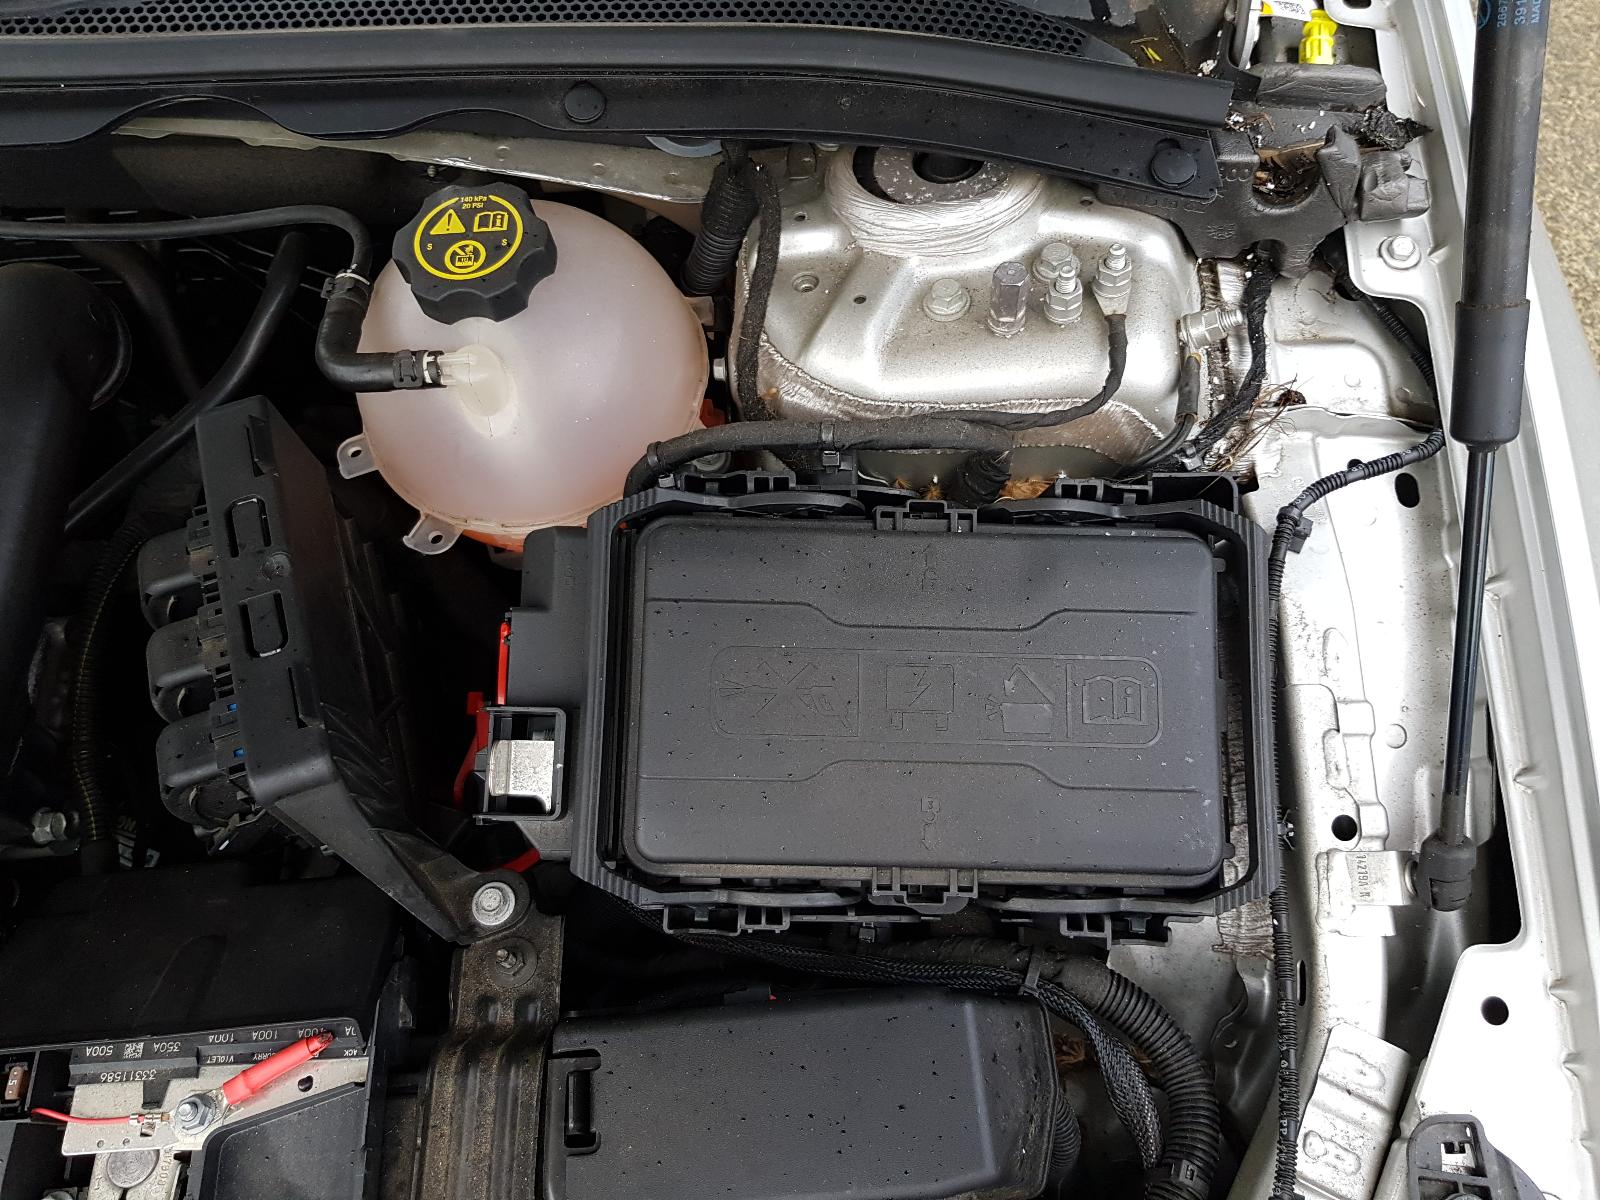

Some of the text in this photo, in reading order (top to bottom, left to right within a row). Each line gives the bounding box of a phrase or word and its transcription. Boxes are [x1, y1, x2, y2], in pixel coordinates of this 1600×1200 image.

[251, 1030, 279, 1040] 100A
[85, 1045, 114, 1056] 500A
[153, 1041, 181, 1053] 350A
[206, 1055, 234, 1064] VIOLET
[100, 1069, 157, 1083] 33311586
